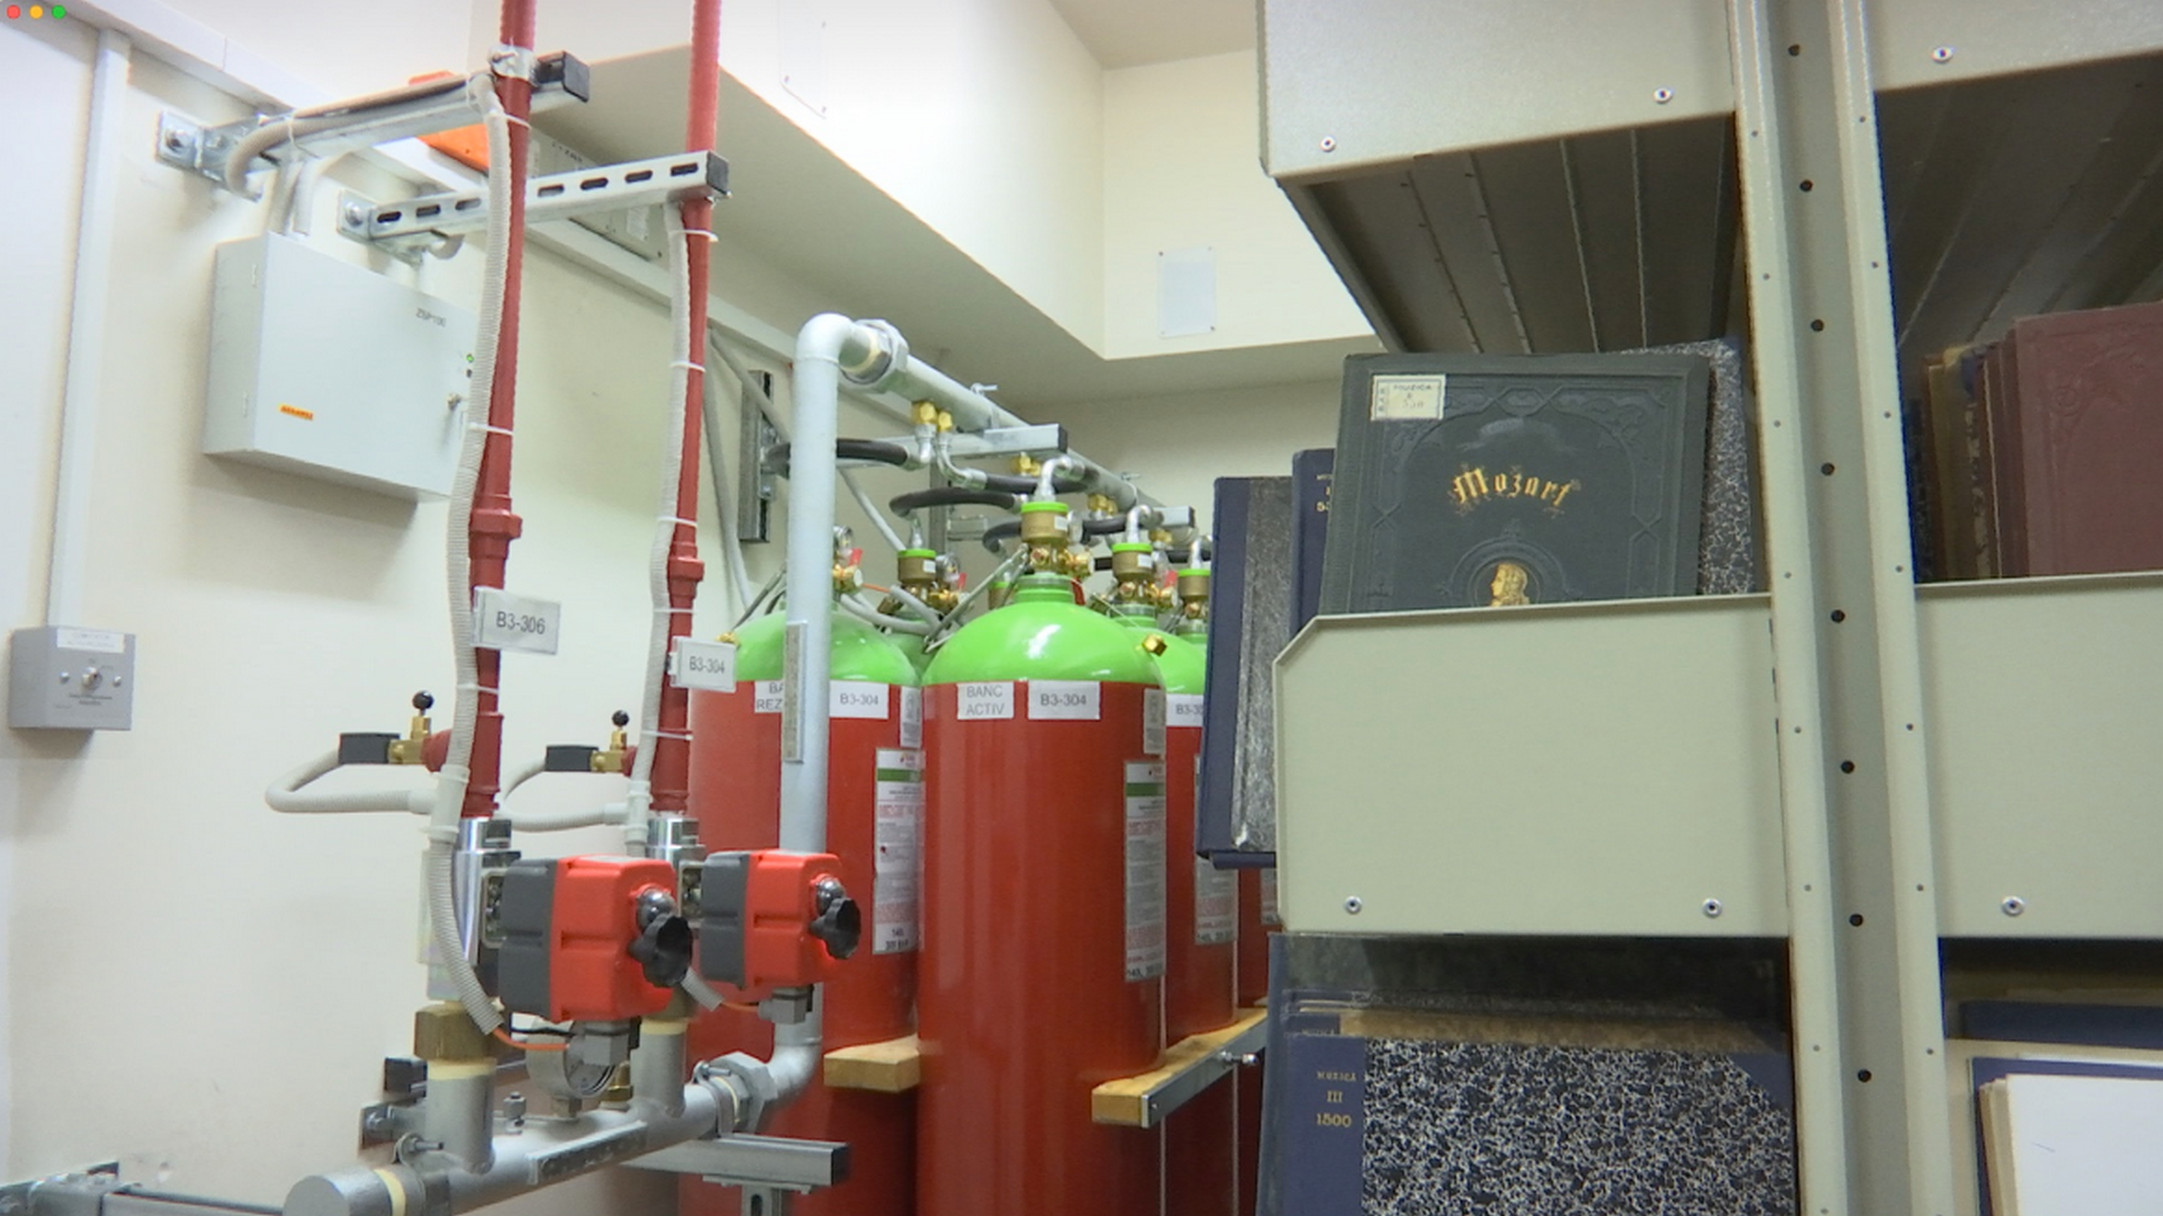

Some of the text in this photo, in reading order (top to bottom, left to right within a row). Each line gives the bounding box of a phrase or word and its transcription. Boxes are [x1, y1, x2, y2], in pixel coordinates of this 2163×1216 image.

[1452, 467, 1573, 508] Mozart
[496, 610, 546, 635] B3-306
[689, 655, 725, 674] B3-304
[769, 683, 784, 694] BA
[966, 685, 1003, 698] BANC
[756, 699, 783, 711] REZ
[840, 693, 879, 705] B3-304
[1040, 694, 1087, 706] B3-304
[966, 703, 1005, 716] ACTIV
[1327, 1090, 1343, 1103] III
